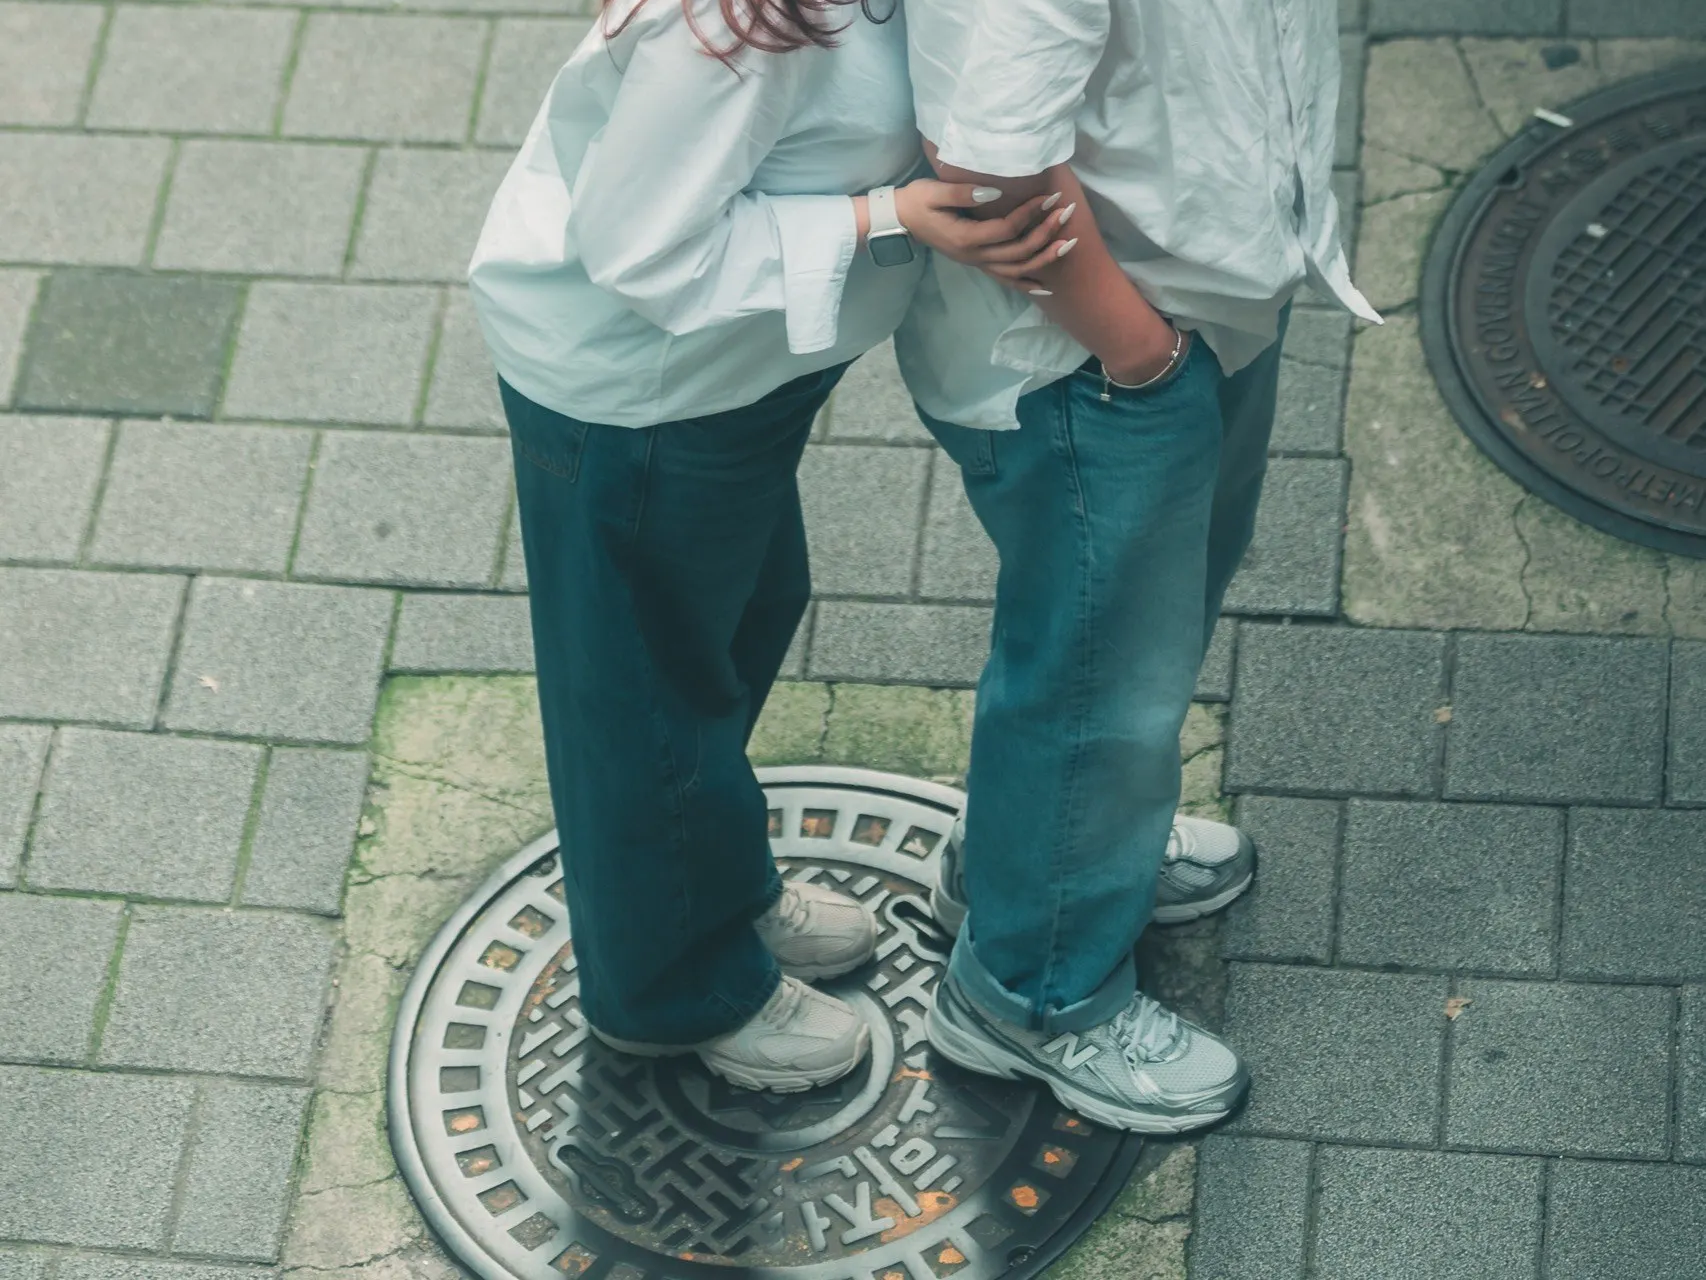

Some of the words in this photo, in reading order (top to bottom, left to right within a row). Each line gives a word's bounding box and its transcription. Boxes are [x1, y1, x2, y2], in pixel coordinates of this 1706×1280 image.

[1475, 198, 1548, 363] GOVERNMENT
[1495, 370, 1706, 515] METROPOLITAN
[1041, 1032, 1101, 1071] N
